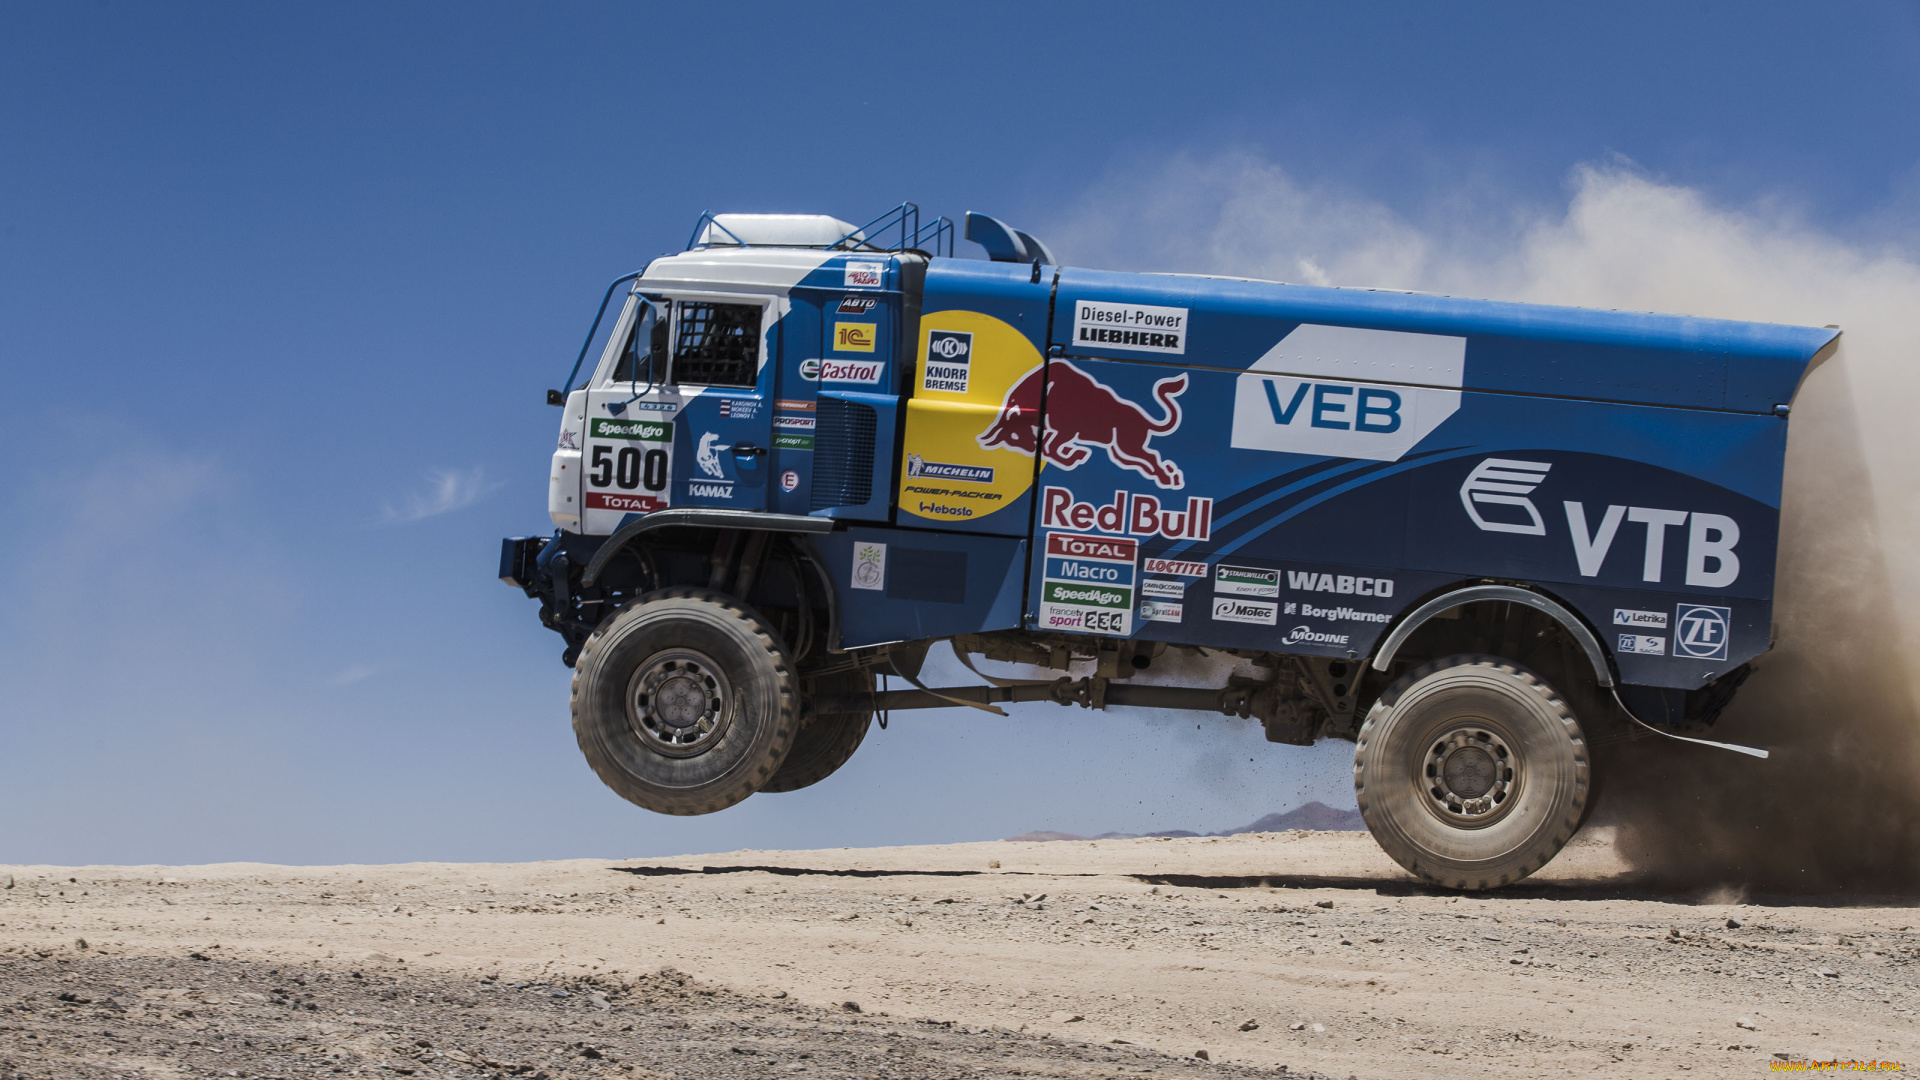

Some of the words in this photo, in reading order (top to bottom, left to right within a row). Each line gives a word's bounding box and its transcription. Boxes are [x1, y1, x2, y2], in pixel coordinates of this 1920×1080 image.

[1081, 306, 1182, 328] Diesel-Power
[1079, 327, 1179, 348] LIEBHERR
[821, 361, 877, 381] Castrol
[926, 365, 968, 380] KNORR
[925, 379, 967, 392] BREMSE
[1262, 379, 1402, 434] VEB
[598, 421, 664, 438] SpeedAgro
[774, 417, 815, 426] PROSPORT
[590, 444, 668, 491] 500
[924, 465, 991, 478] MICHELIN
[689, 484, 734, 499] KAMAZ
[904, 485, 1003, 500] POWER-PACKER
[602, 495, 651, 509] TOTAL
[919, 501, 973, 517] Webasto
[1043, 487, 1127, 533] Red
[1130, 494, 1212, 540] Bull
[1058, 537, 1126, 557] TOTAL
[1563, 500, 1741, 588] VTB
[1061, 561, 1119, 581] Macro
[1146, 559, 1206, 576] LOCTITE
[1287, 570, 1394, 598] WABCO
[1053, 587, 1123, 604] SpeedAgro
[1049, 615, 1082, 627] sport
[1301, 603, 1392, 623] BorgWarner
[1632, 612, 1666, 624] Letrika
[1290, 630, 1350, 644] MODINE
[1682, 616, 1724, 647] ZF
